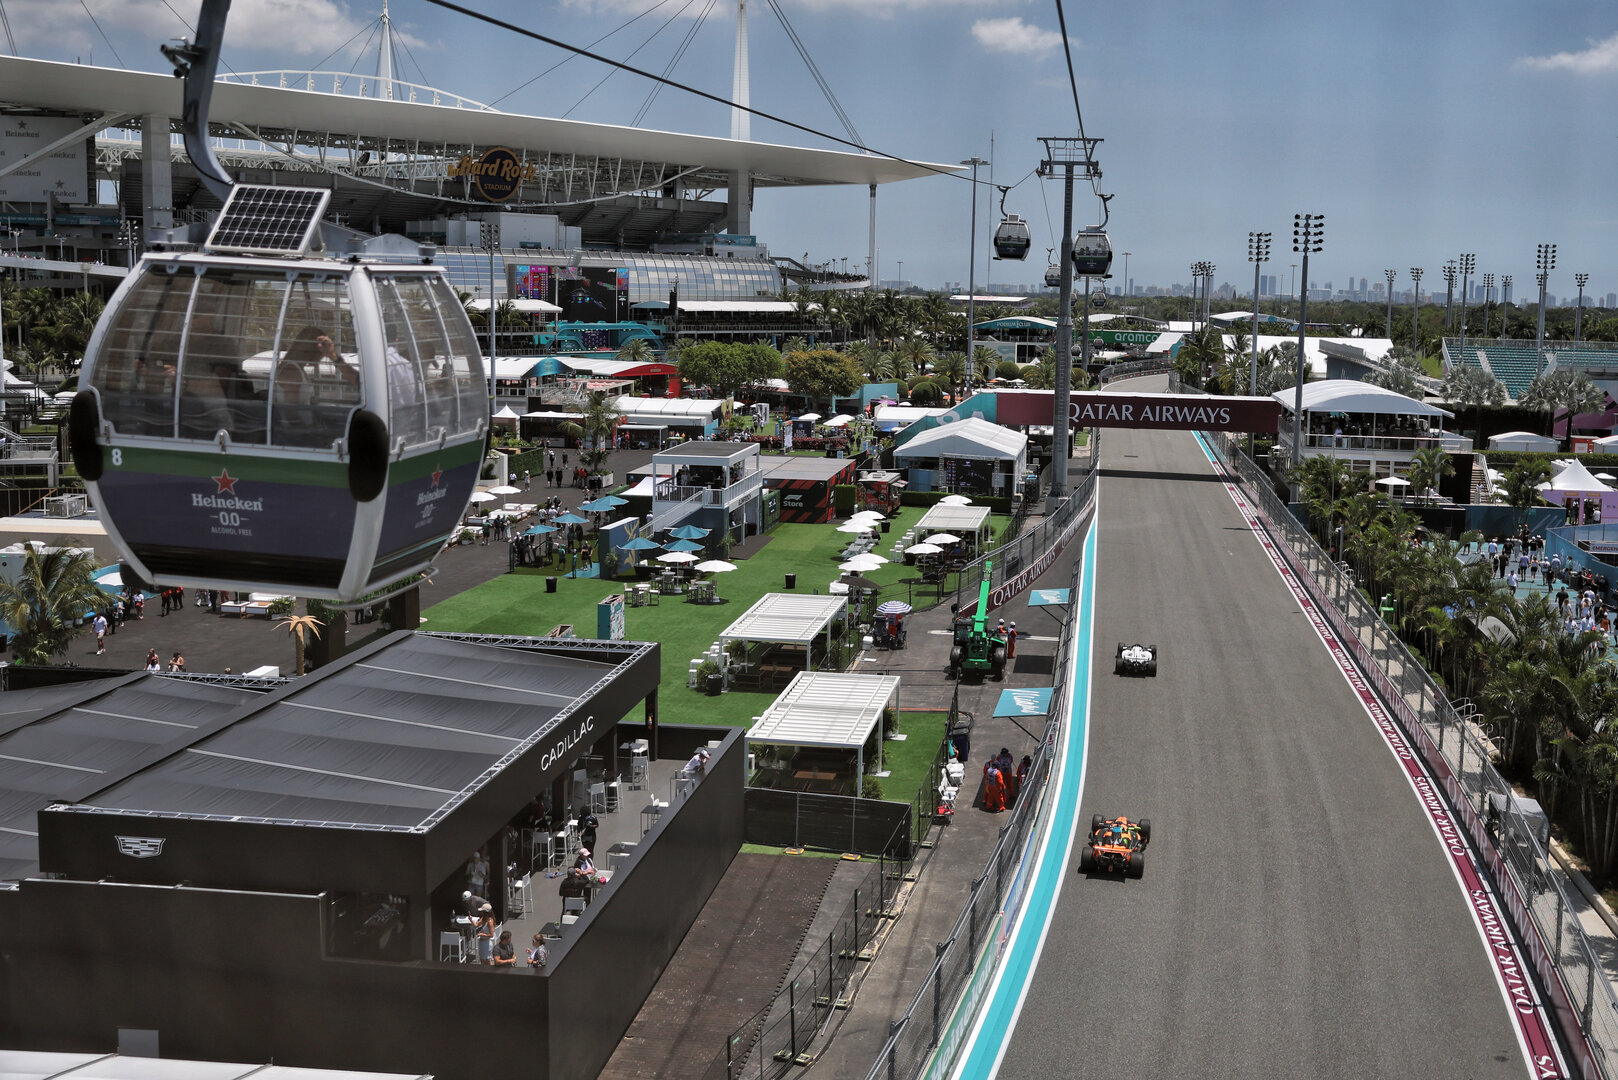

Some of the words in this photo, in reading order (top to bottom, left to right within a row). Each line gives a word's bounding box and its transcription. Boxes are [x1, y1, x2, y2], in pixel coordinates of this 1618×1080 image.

[457, 156, 501, 177] Hard
[500, 159, 536, 182] Rock
[484, 183, 511, 191] STADIUM
[1114, 331, 1159, 343] aramco
[1069, 402, 1134, 423] QATAR
[1140, 405, 1231, 424] AIRWAYS
[111, 448, 123, 466] 8
[191, 493, 263, 512] Heineken
[993, 573, 1028, 606] QATAR
[1028, 548, 1056, 583] AIRWAYS
[1366, 702, 1395, 733] AIRWAYS
[1386, 684, 1428, 757] AIRWAYS
[541, 715, 594, 771] CADILLAC
[1387, 732, 1412, 760] QATAR
[1413, 776, 1446, 817] AIRWAYS
[1436, 819, 1466, 856] QATAR
[1447, 774, 1488, 863] QATAR
[1490, 854, 1552, 997] AIRWAYS
[1470, 889, 1511, 952] AIRWAYS
[1498, 955, 1534, 1015] QATAR
